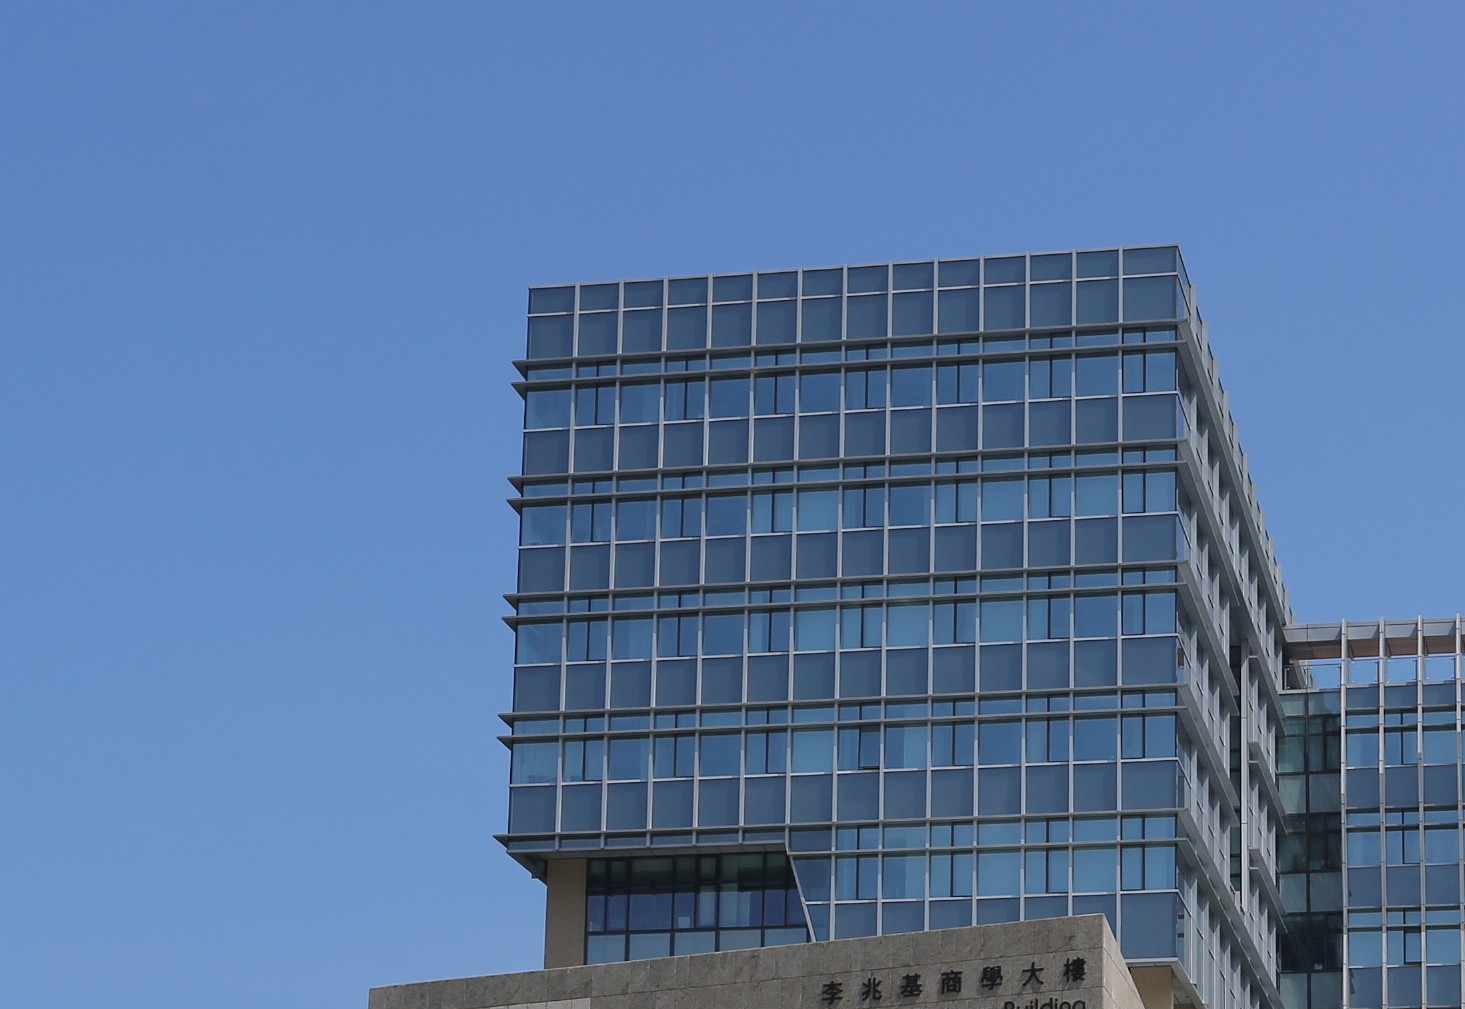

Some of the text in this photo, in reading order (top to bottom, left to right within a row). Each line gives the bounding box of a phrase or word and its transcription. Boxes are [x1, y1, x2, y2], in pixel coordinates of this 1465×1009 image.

[821, 956, 1087, 1005] 李兆基商學大樓
